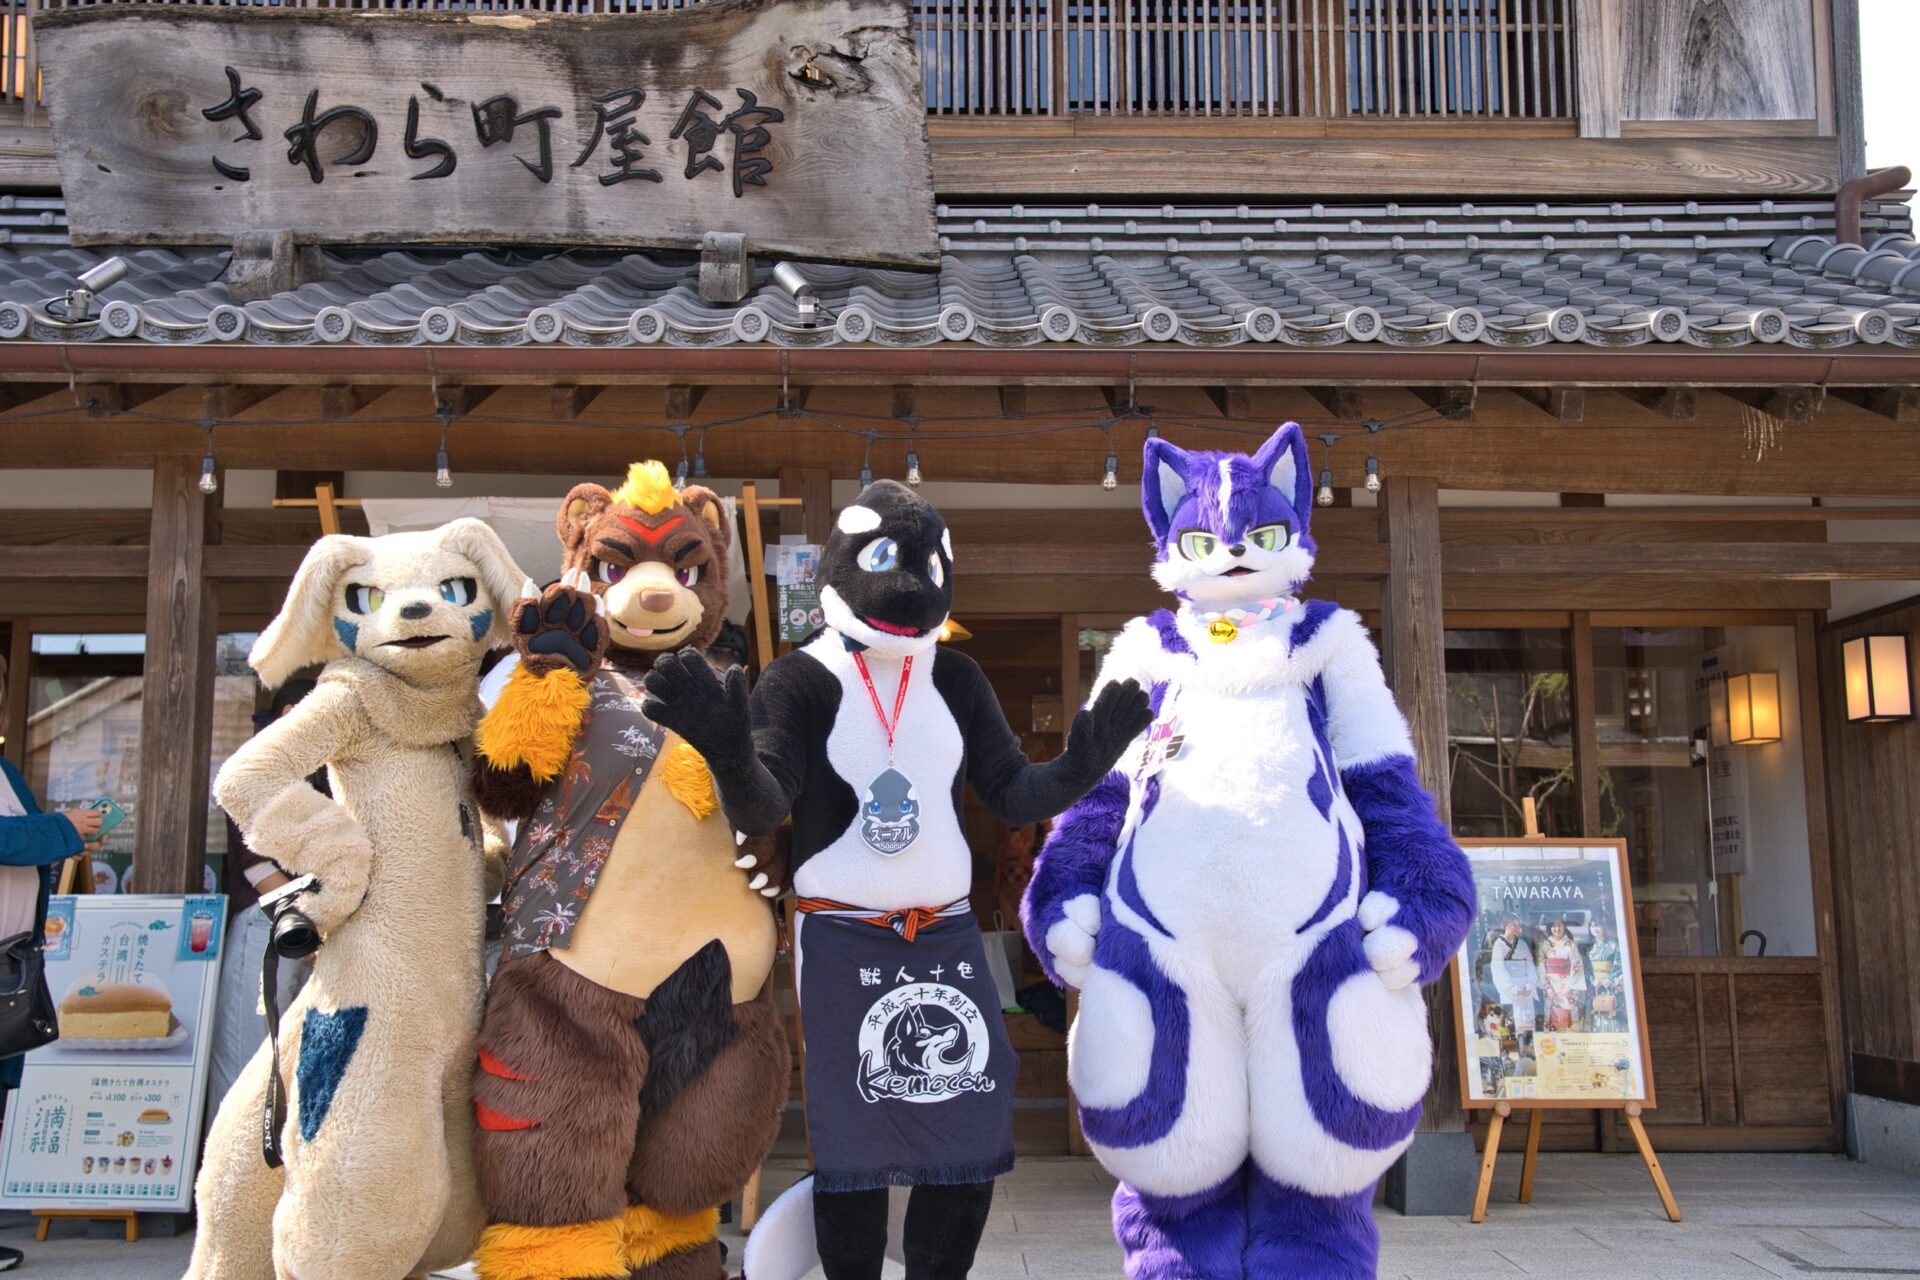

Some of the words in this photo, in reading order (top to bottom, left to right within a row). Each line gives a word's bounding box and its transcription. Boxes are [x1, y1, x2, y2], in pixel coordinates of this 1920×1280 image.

[202, 65, 784, 198] さわら町屋館
[871, 826, 913, 842] スーアル
[1491, 886, 1584, 899] TAWARAYA
[97, 935, 111, 983] カステラ
[117, 934, 130, 962] 台湾
[134, 934, 149, 984] 焼きたて
[867, 987, 978, 1031] 平成二十年創立
[857, 1050, 996, 1104] Kemocon
[265, 1110, 273, 1150] SONY
